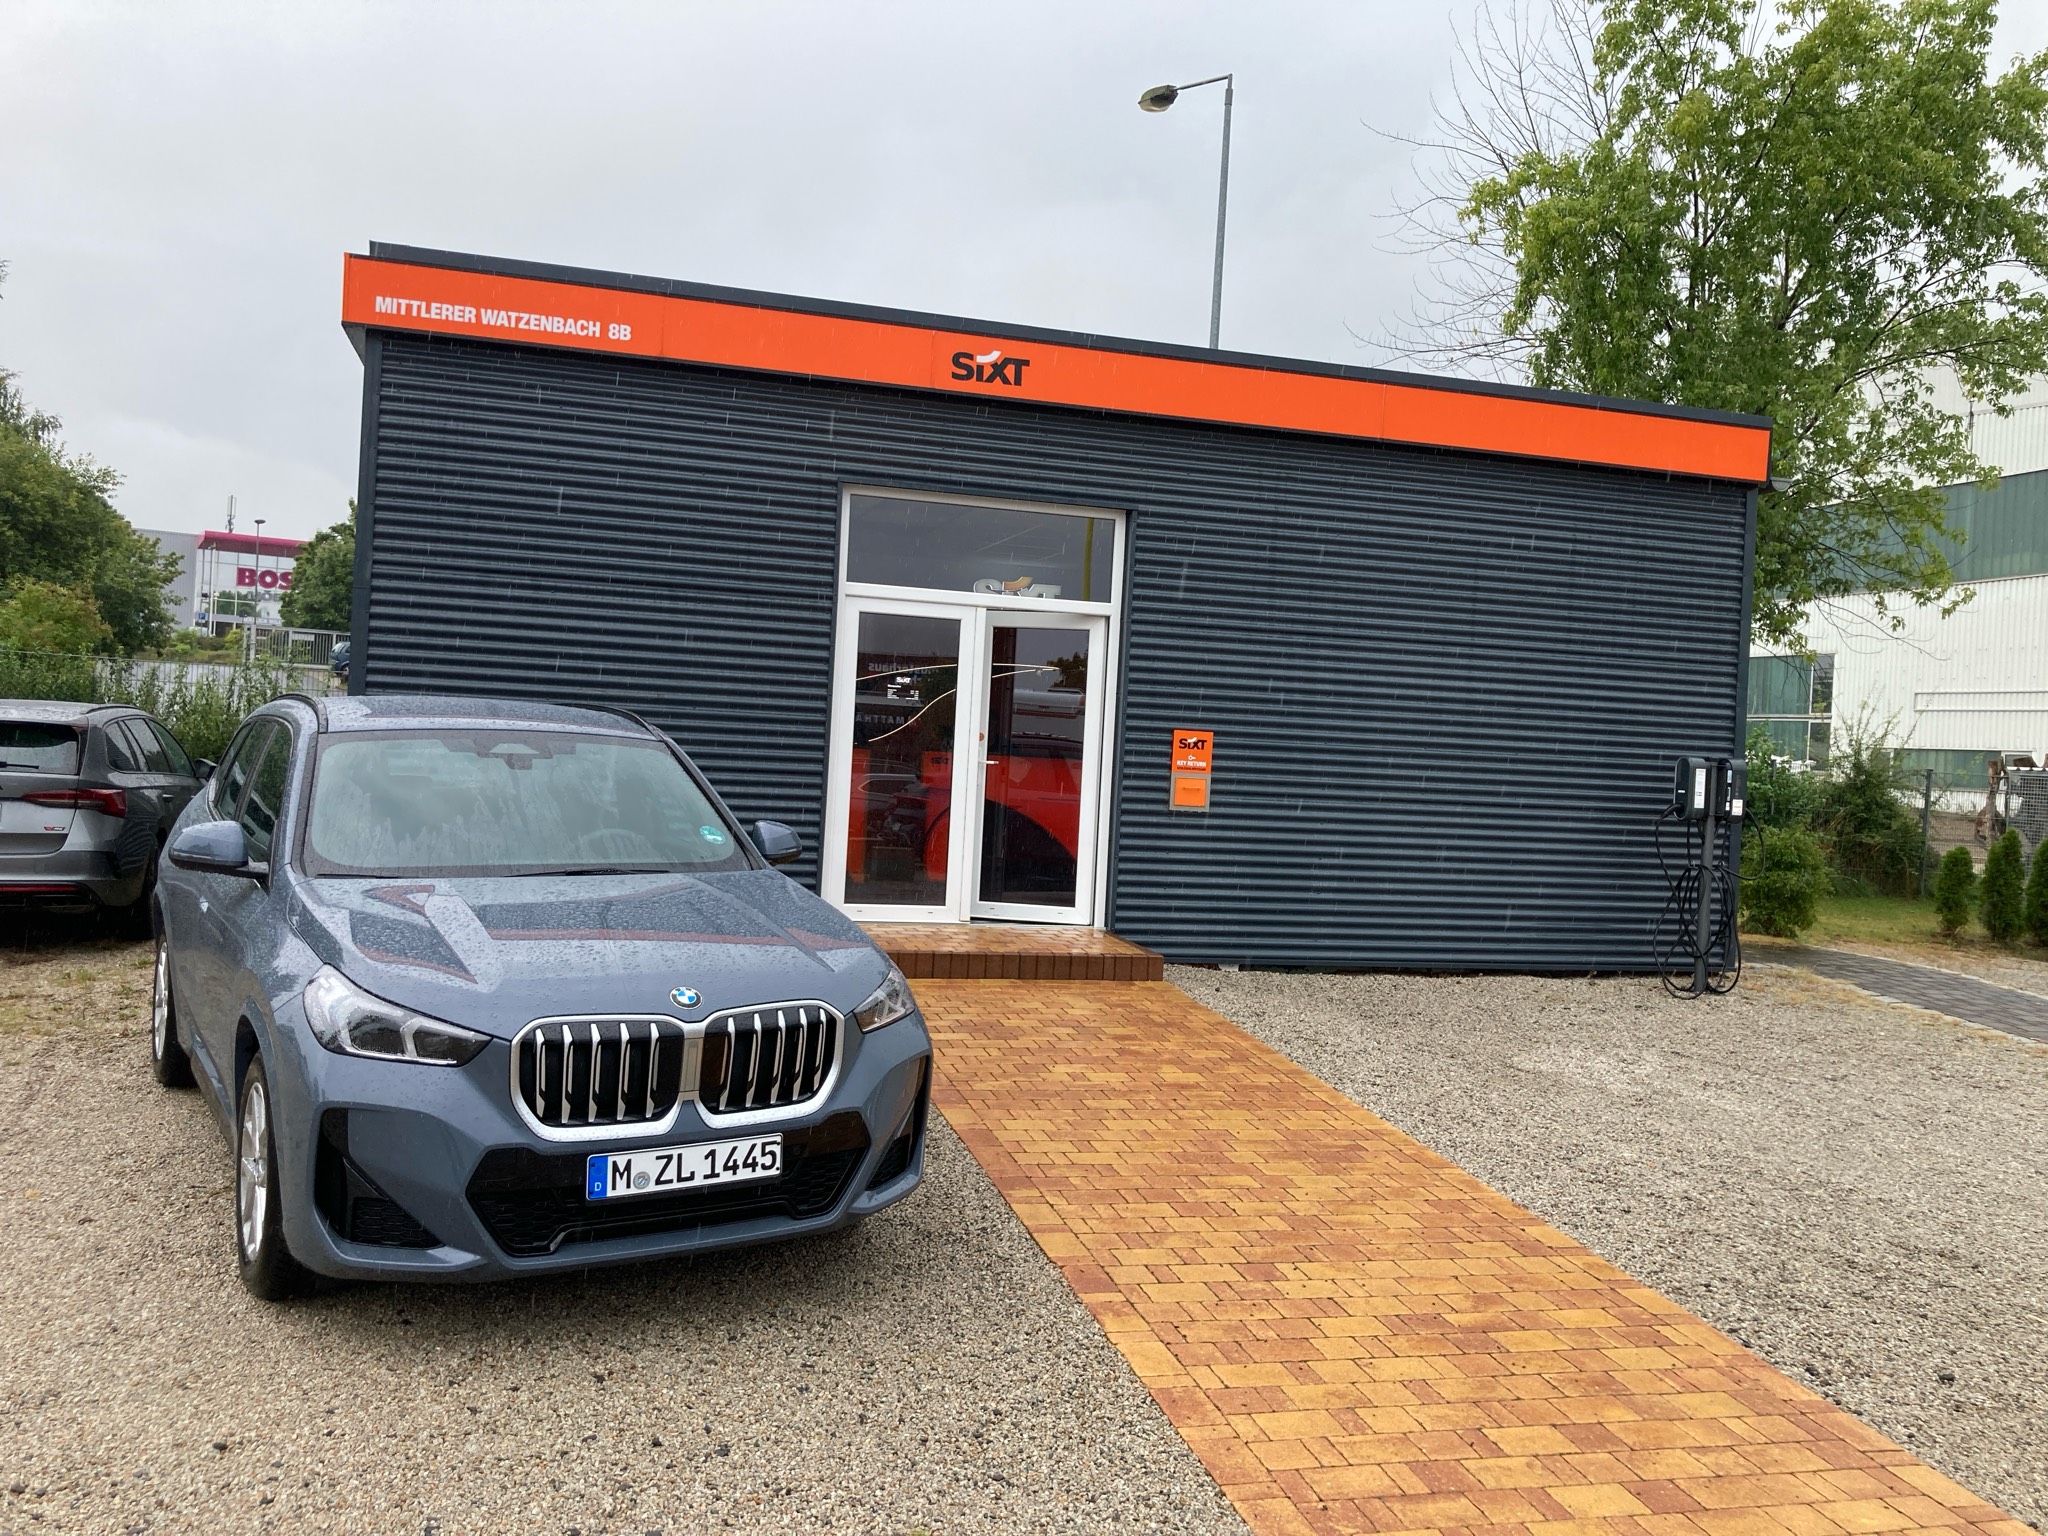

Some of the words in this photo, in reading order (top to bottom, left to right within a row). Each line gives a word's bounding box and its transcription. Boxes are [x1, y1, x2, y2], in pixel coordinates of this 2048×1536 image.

[375, 296, 476, 324] MITTLERER
[480, 308, 600, 338] WATZENBACH
[608, 323, 632, 341] 8B
[951, 350, 1030, 387] SIXT
[1179, 737, 1208, 750] SIXT
[611, 1158, 632, 1191] M
[655, 1153, 695, 1186] ZL
[702, 1140, 778, 1180] 1445
[594, 1182, 602, 1191] D
